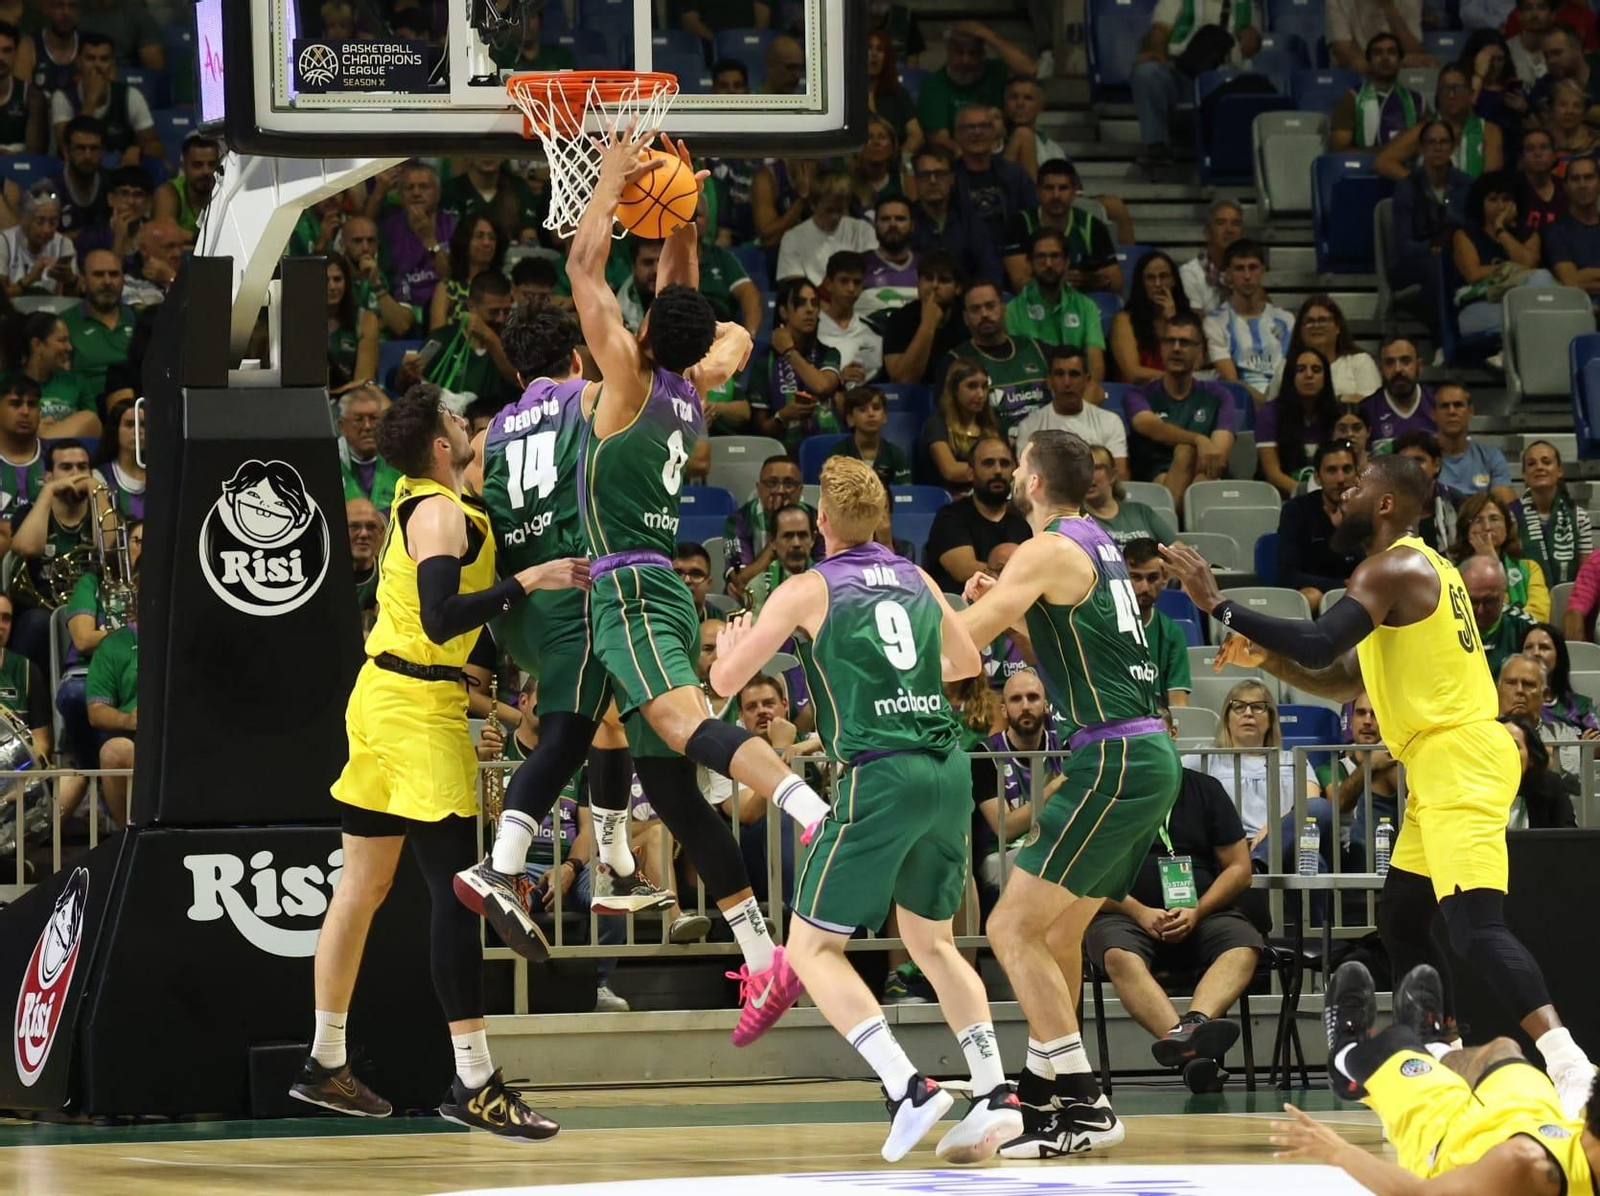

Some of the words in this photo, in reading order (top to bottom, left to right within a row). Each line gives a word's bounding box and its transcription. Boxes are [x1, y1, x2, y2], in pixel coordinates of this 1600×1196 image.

[341, 54, 422, 65] CHAMPIONS
[342, 44, 413, 53] BASKETBALL
[342, 66, 386, 75] LEAGUE
[343, 78, 377, 87] SEASON
[379, 78, 386, 86] X
[505, 430, 558, 510] 14
[220, 549, 309, 596] Risi
[875, 600, 918, 671] 9
[19, 992, 54, 1052] Risi
